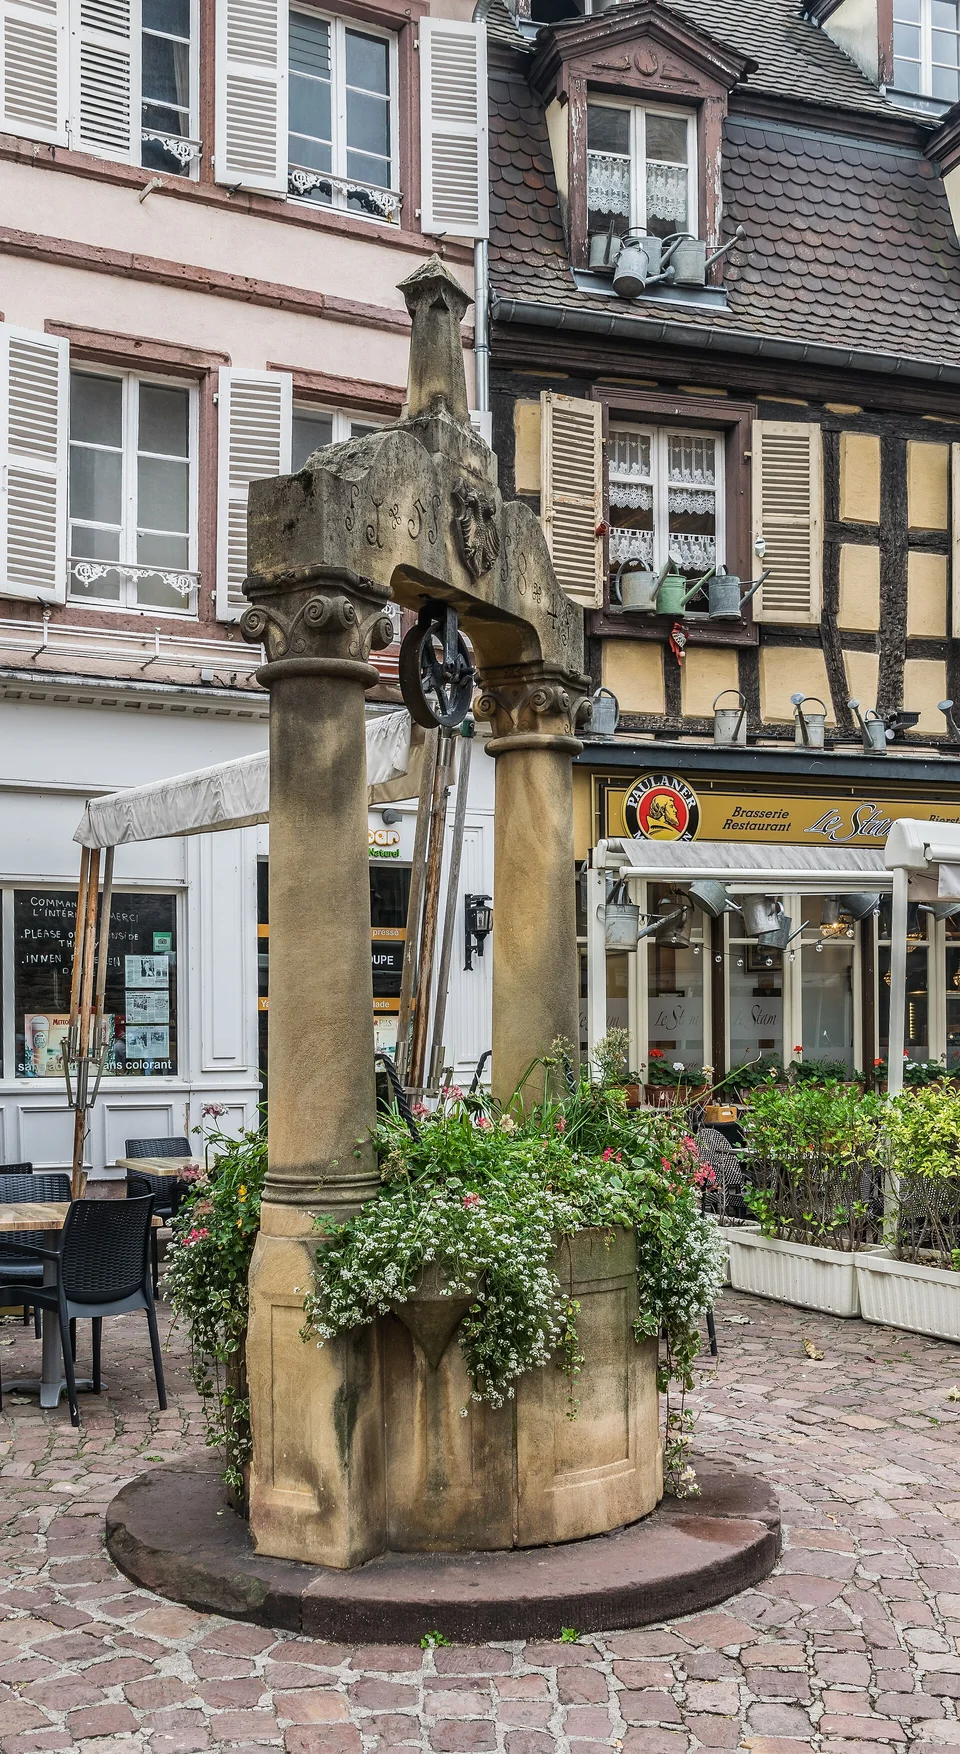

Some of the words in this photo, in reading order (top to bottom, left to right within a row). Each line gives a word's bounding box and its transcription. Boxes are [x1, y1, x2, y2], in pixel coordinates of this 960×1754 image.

[627, 775, 697, 809] PAULANER
[731, 806, 790, 819] Brasserie
[722, 818, 792, 832] Restaurant
[803, 808, 843, 833] Le
[829, 802, 894, 842] Sta
[372, 928, 399, 937] pressé
[373, 1000, 390, 1008] lade
[653, 1010, 669, 1027] Le
[749, 1004, 777, 1027] Stam
[18, 1062, 46, 1072] sans
[125, 1059, 172, 1070] colorant
